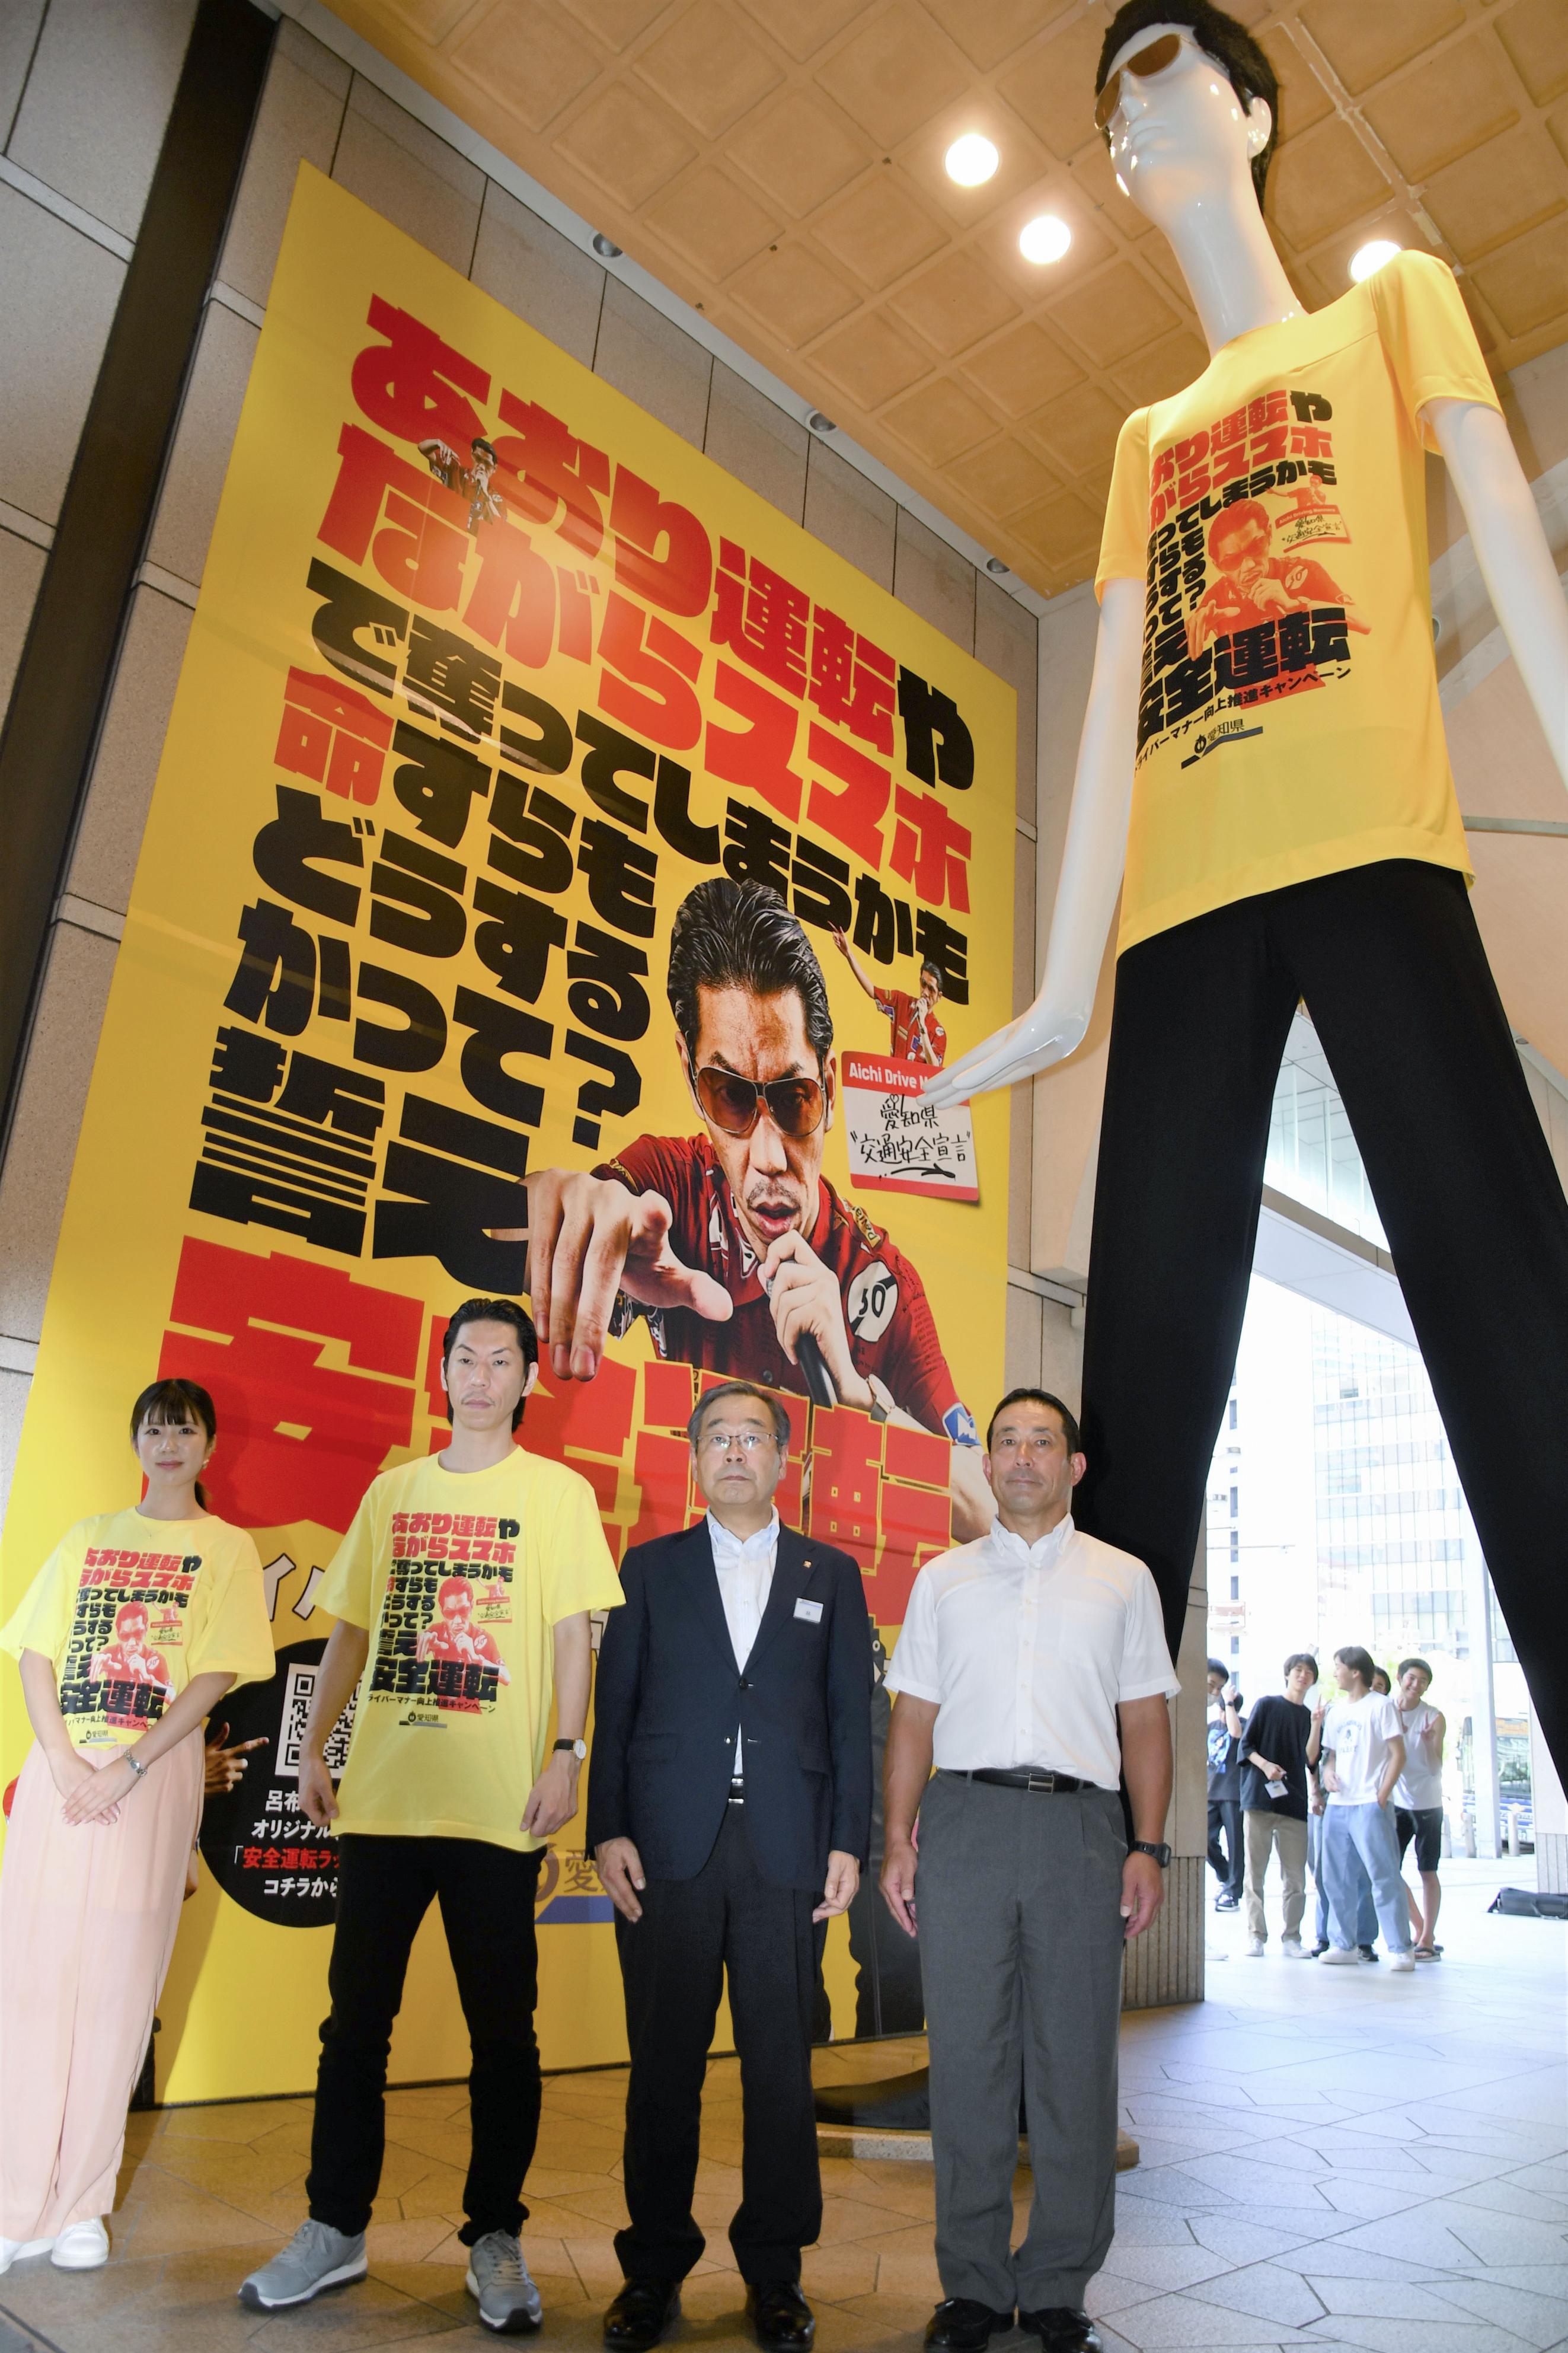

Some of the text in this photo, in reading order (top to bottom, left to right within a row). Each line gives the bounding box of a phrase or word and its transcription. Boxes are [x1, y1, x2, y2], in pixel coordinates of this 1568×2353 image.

[317, 422, 971, 914] ながらスマホ
[352, 293, 975, 790] あおり運転や
[274, 665, 659, 938] 命すらも
[306, 557, 969, 1005] で奪ってしまうかも
[1207, 719, 1244, 745] 愛知県
[253, 784, 650, 1041] どうする
[189, 1026, 531, 1296] 誓え
[850, 1062, 882, 1083] Aichi
[885, 1069, 916, 1088] Drive
[251, 1819, 338, 1841] オリジナル
